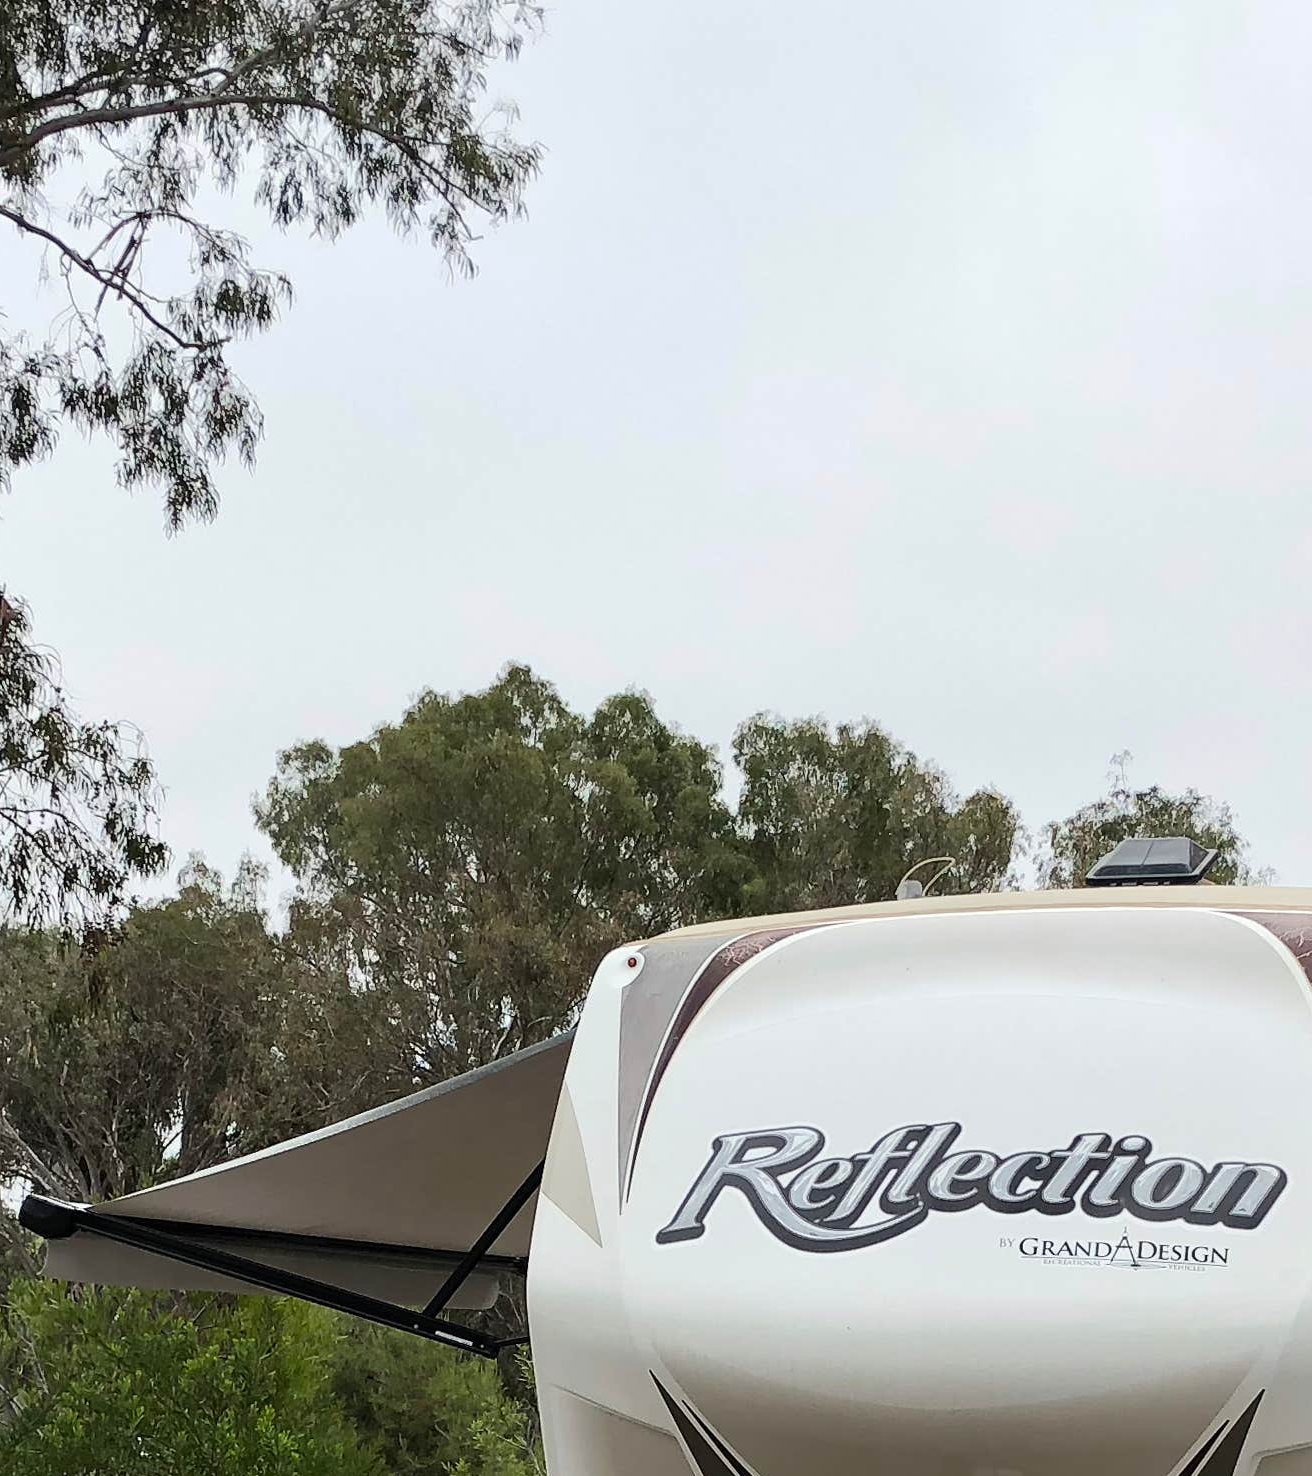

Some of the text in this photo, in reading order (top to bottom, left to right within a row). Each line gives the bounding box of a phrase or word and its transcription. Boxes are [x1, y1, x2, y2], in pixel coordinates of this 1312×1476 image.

[656, 1122, 1288, 1253] Reflection
[999, 1238, 1016, 1248] BY
[1019, 1237, 1229, 1264] GRAND DESIGN
